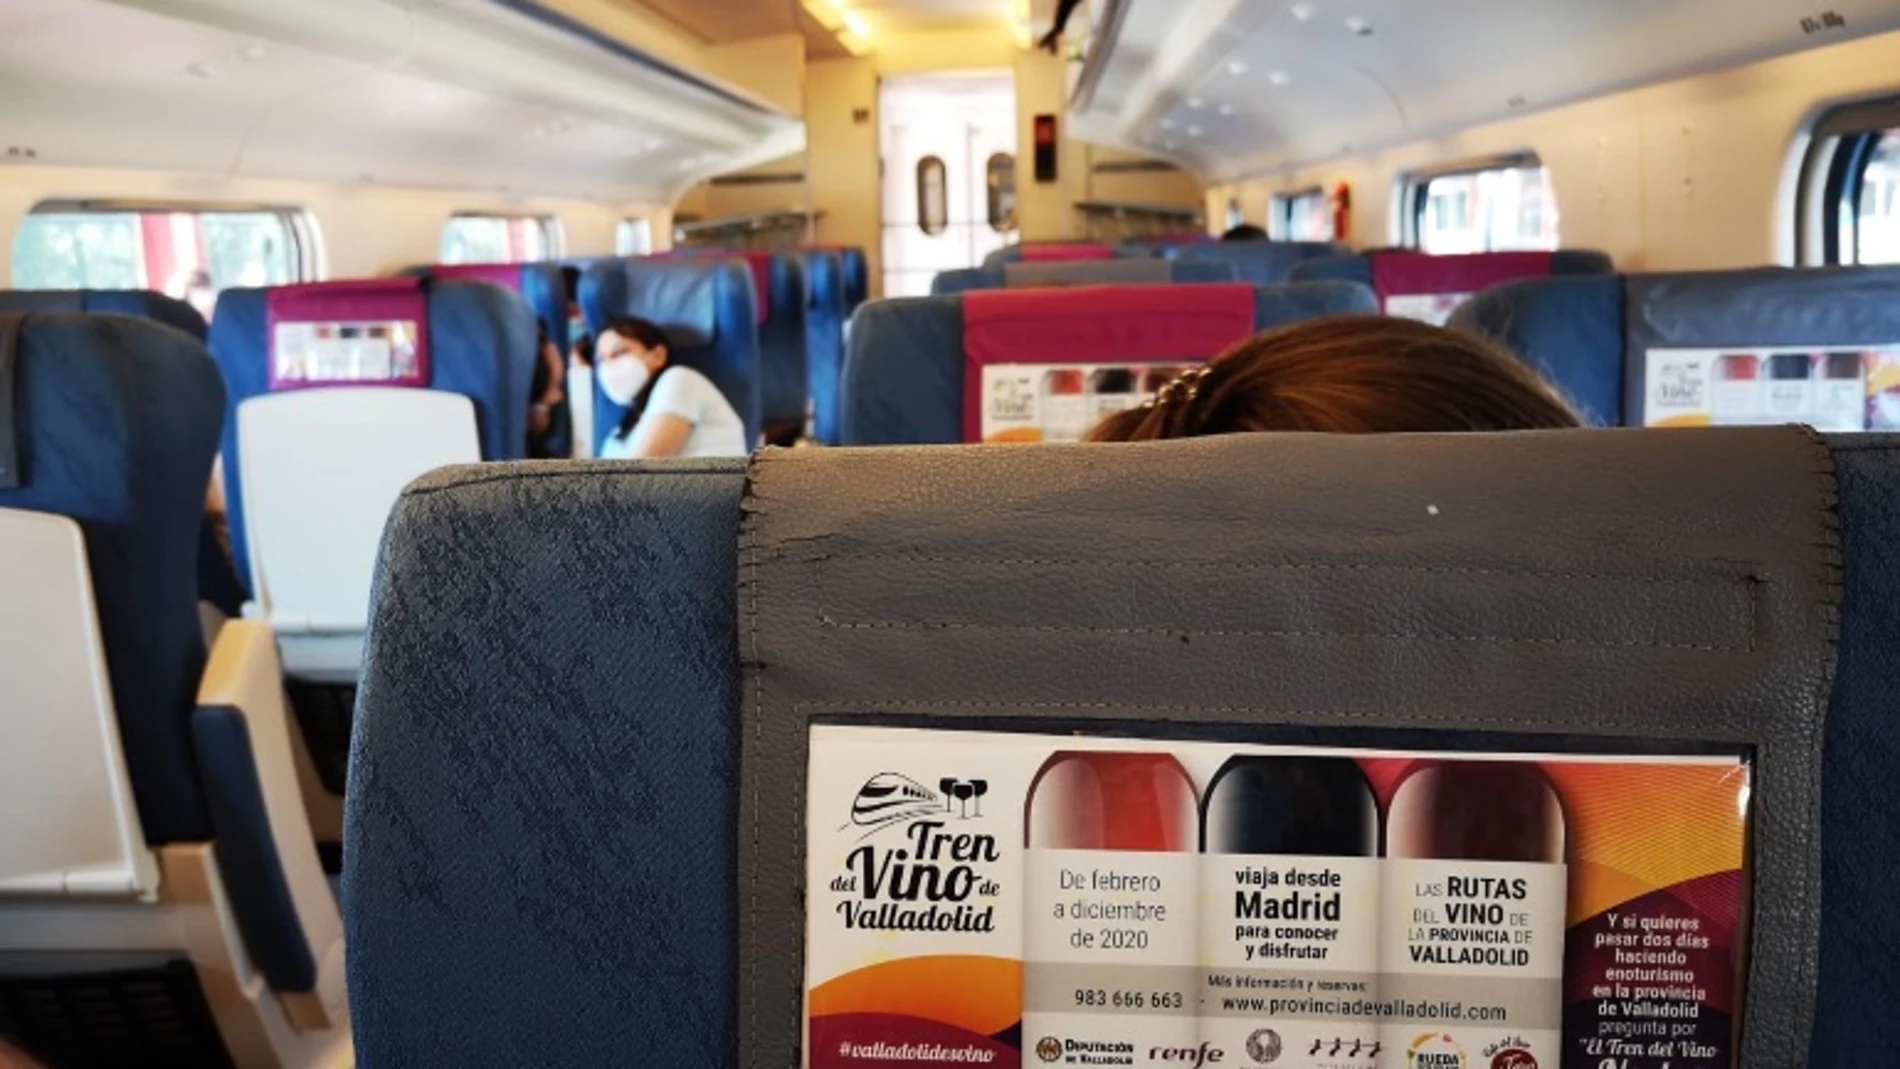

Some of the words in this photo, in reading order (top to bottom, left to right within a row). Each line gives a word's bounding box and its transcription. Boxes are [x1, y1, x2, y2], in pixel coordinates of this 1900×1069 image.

[908, 820, 1000, 862] Tren
[830, 875, 857, 892] del
[846, 845, 982, 902] Vino
[979, 880, 1000, 897] de
[1060, 869, 1086, 890] De
[1092, 868, 1161, 892] febrero
[1235, 866, 1279, 889] viaja
[1285, 867, 1341, 888] desde
[1415, 882, 1443, 898] LAS
[1447, 875, 1527, 900] RUTAS
[836, 900, 995, 932] Valladolid
[1053, 902, 1065, 920] a
[1070, 899, 1166, 922] diciembre
[1235, 891, 1340, 922] Madrid
[1413, 907, 1440, 924] DEL
[1445, 902, 1504, 925] VINO
[1510, 912, 1528, 927] DE
[1235, 924, 1270, 941] para
[1275, 926, 1339, 941] conocer
[1608, 912, 1618, 928] Y
[1622, 912, 1637, 930] si
[1640, 914, 1700, 932] quieres
[1070, 928, 1094, 949] de
[1100, 929, 1149, 950] 2020
[1408, 928, 1425, 942] LA
[1429, 927, 1510, 944] PROVINCIA
[1514, 930, 1533, 944] DE
[1594, 932, 1639, 949] pasar
[1643, 932, 1672, 948] dos
[1675, 933, 1710, 949] días
[1245, 944, 1254, 960] y
[1259, 943, 1328, 960] disfrutar
[1409, 944, 1529, 966] VALLADOLID
[1615, 948, 1687, 965] haciendo
[1605, 966, 1695, 983] enoturismo
[1307, 981, 1314, 993] y
[1593, 984, 1612, 998] en
[1615, 982, 1630, 999] la
[1635, 983, 1706, 1002] provincia
[1074, 989, 1107, 1006] 983
[1112, 991, 1144, 1008] 666
[1151, 992, 1183, 1009] 663
[1222, 996, 1507, 1021] www.provinciadevalladolid.com
[1598, 1000, 1617, 1016] de
[1622, 1002, 1699, 1019] Valladolid
[1598, 1021, 1667, 1038] pregunta
[1672, 1024, 1697, 1039] por
[1149, 1040, 1225, 1069] renfe
[1605, 1039, 1644, 1056] Tren
[1647, 1042, 1674, 1058] del
[1677, 1042, 1718, 1059] Vino
